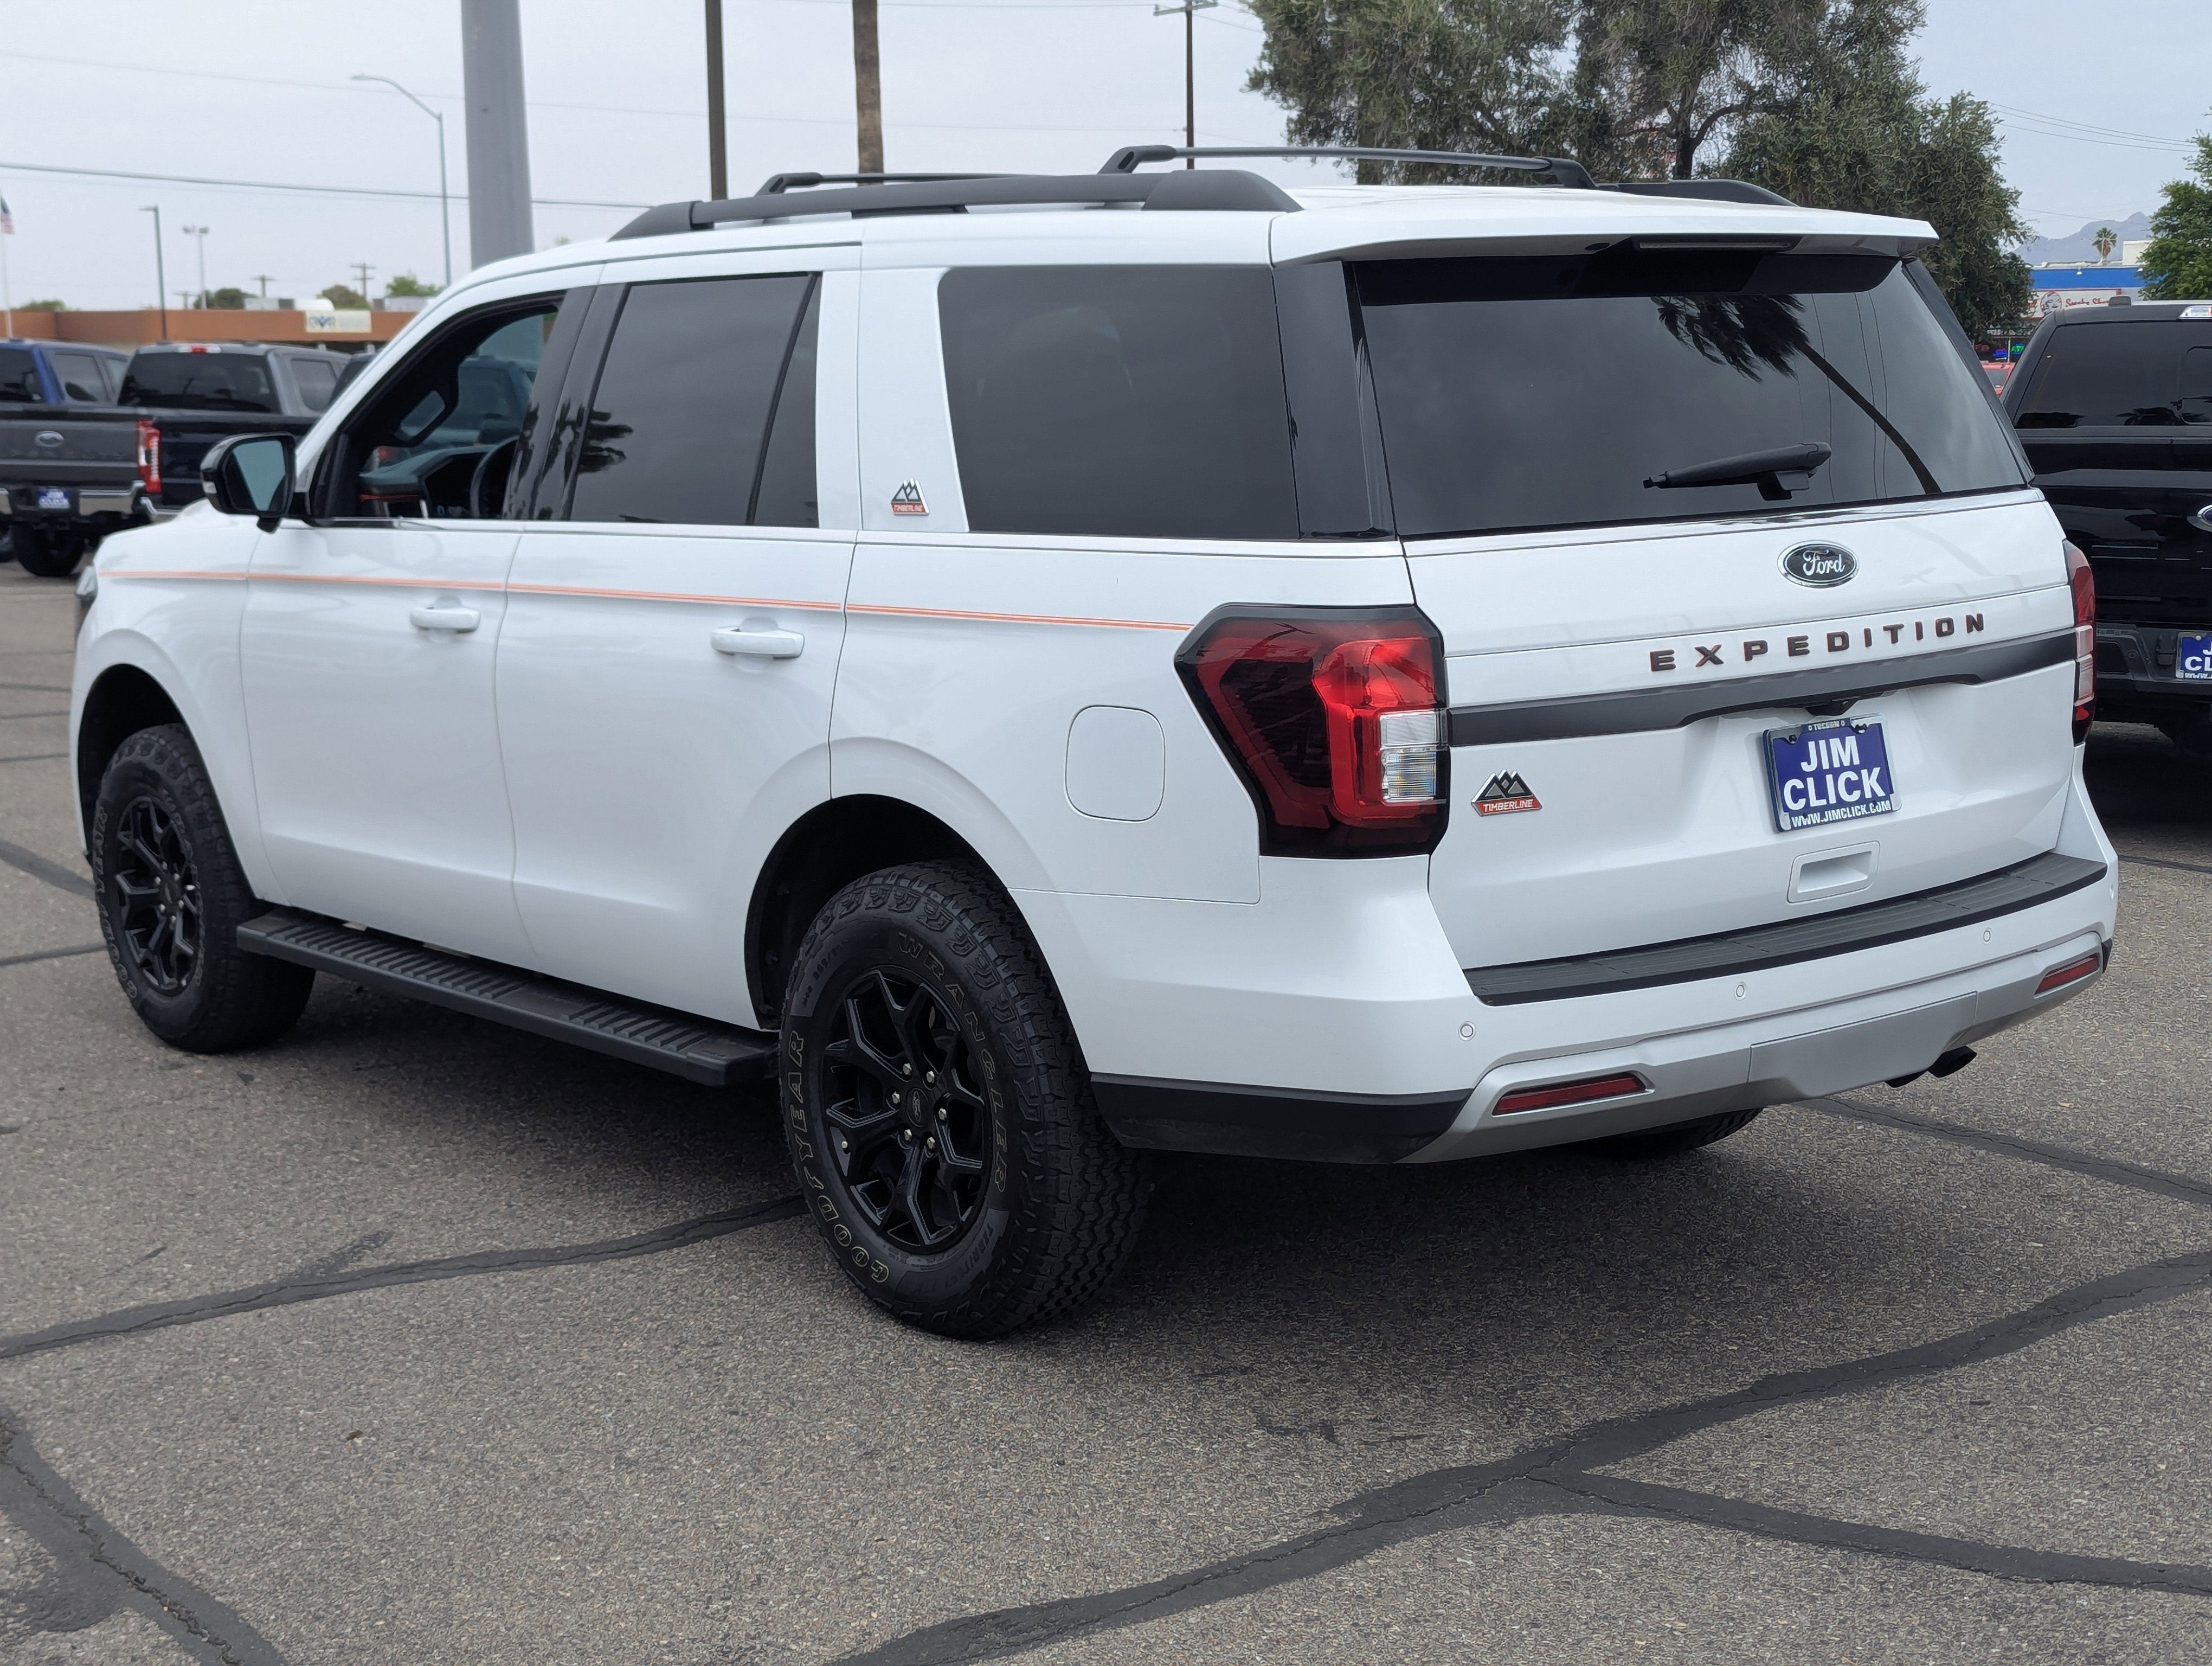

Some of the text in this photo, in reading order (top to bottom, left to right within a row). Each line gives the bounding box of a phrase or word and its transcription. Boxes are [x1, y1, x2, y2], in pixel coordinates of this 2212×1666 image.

[1802, 548, 1846, 576] Ford
[1650, 612, 1984, 672] EXPEDITION
[1801, 735, 1860, 772] JIM
[1482, 799, 1534, 813] TIMBERLINE
[1783, 767, 1886, 810] CLICK
[898, 931, 1008, 1193] WRANGLER
[787, 1030, 890, 1283] GOODYEAR
